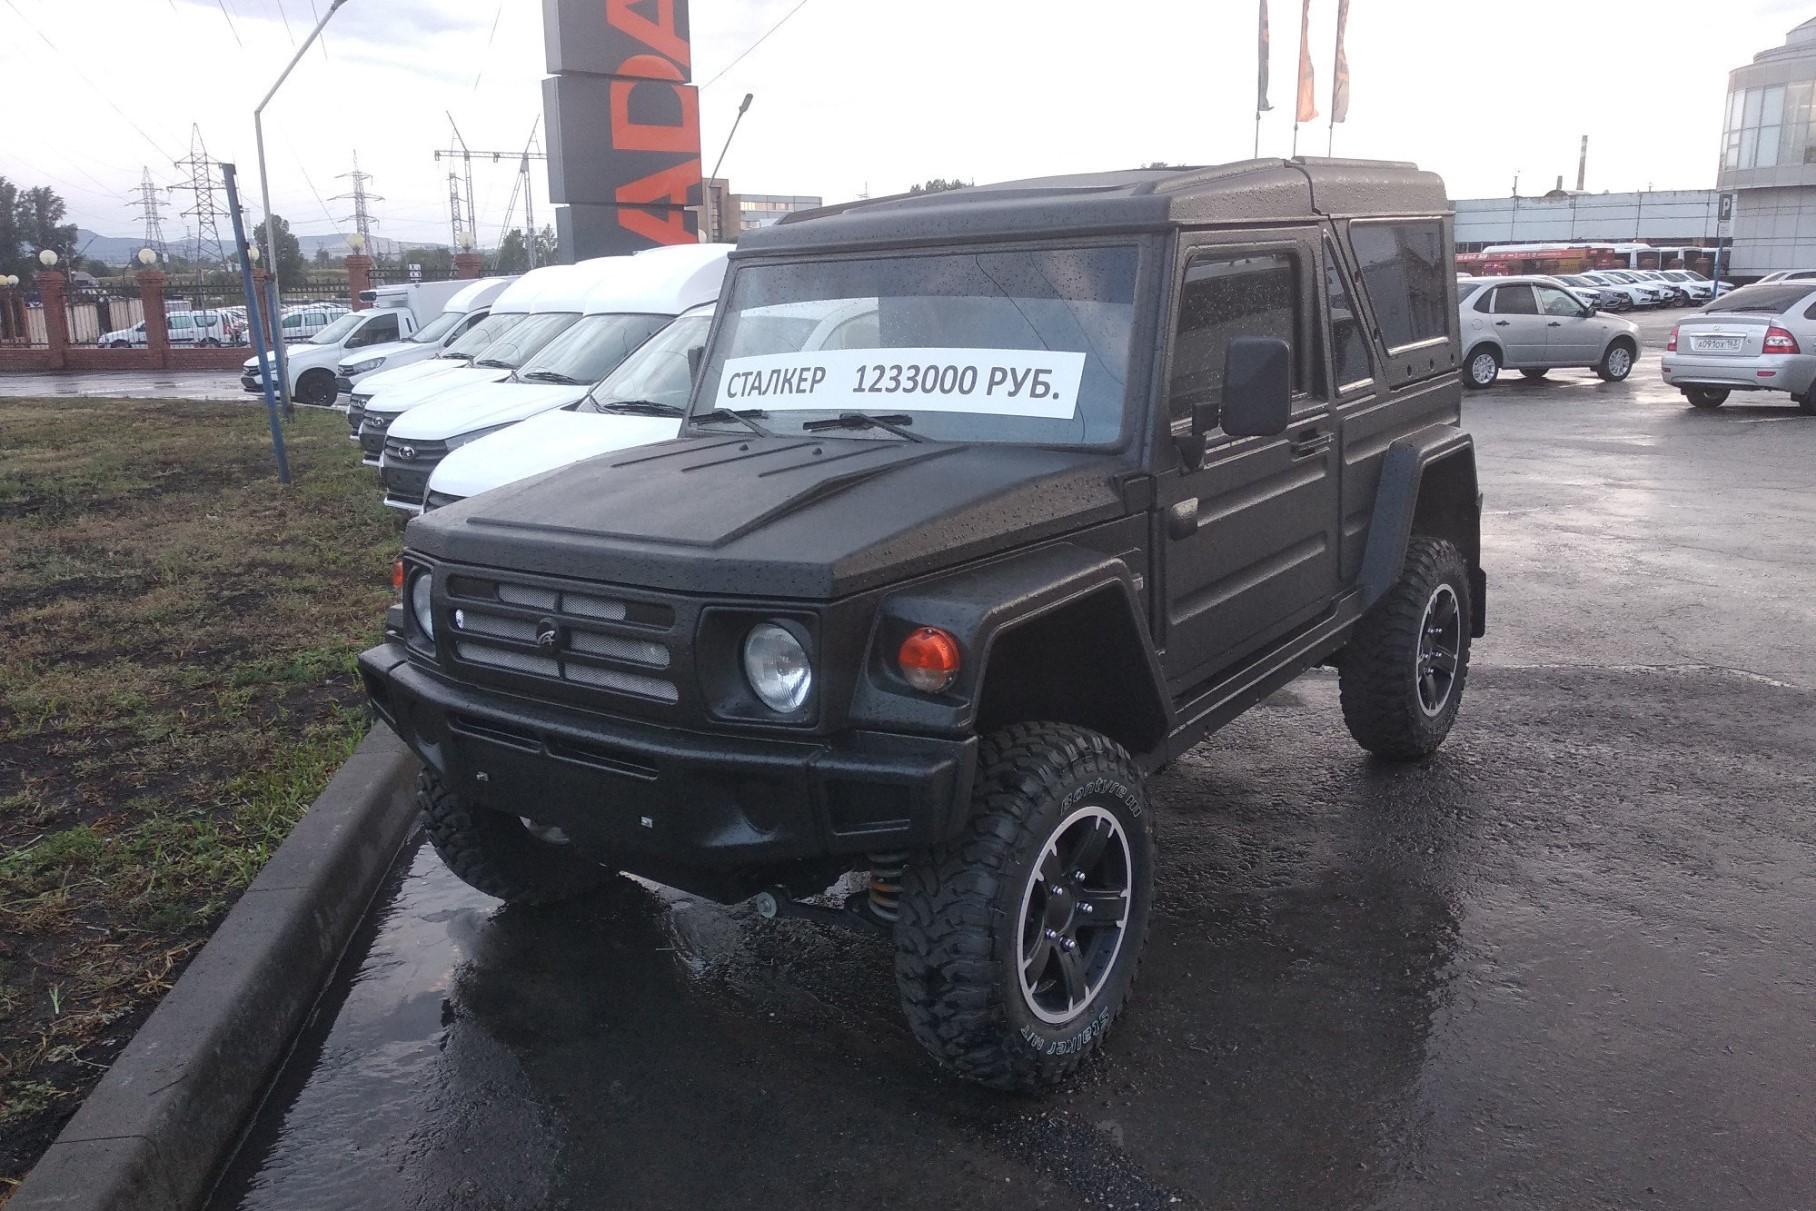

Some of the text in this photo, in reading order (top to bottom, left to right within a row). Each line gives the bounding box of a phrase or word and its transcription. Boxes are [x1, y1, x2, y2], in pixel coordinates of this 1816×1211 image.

[726, 363, 1061, 400] СТАЛКЕР 1233000 РУБ.
[1046, 1005, 1110, 1055] Stalker
